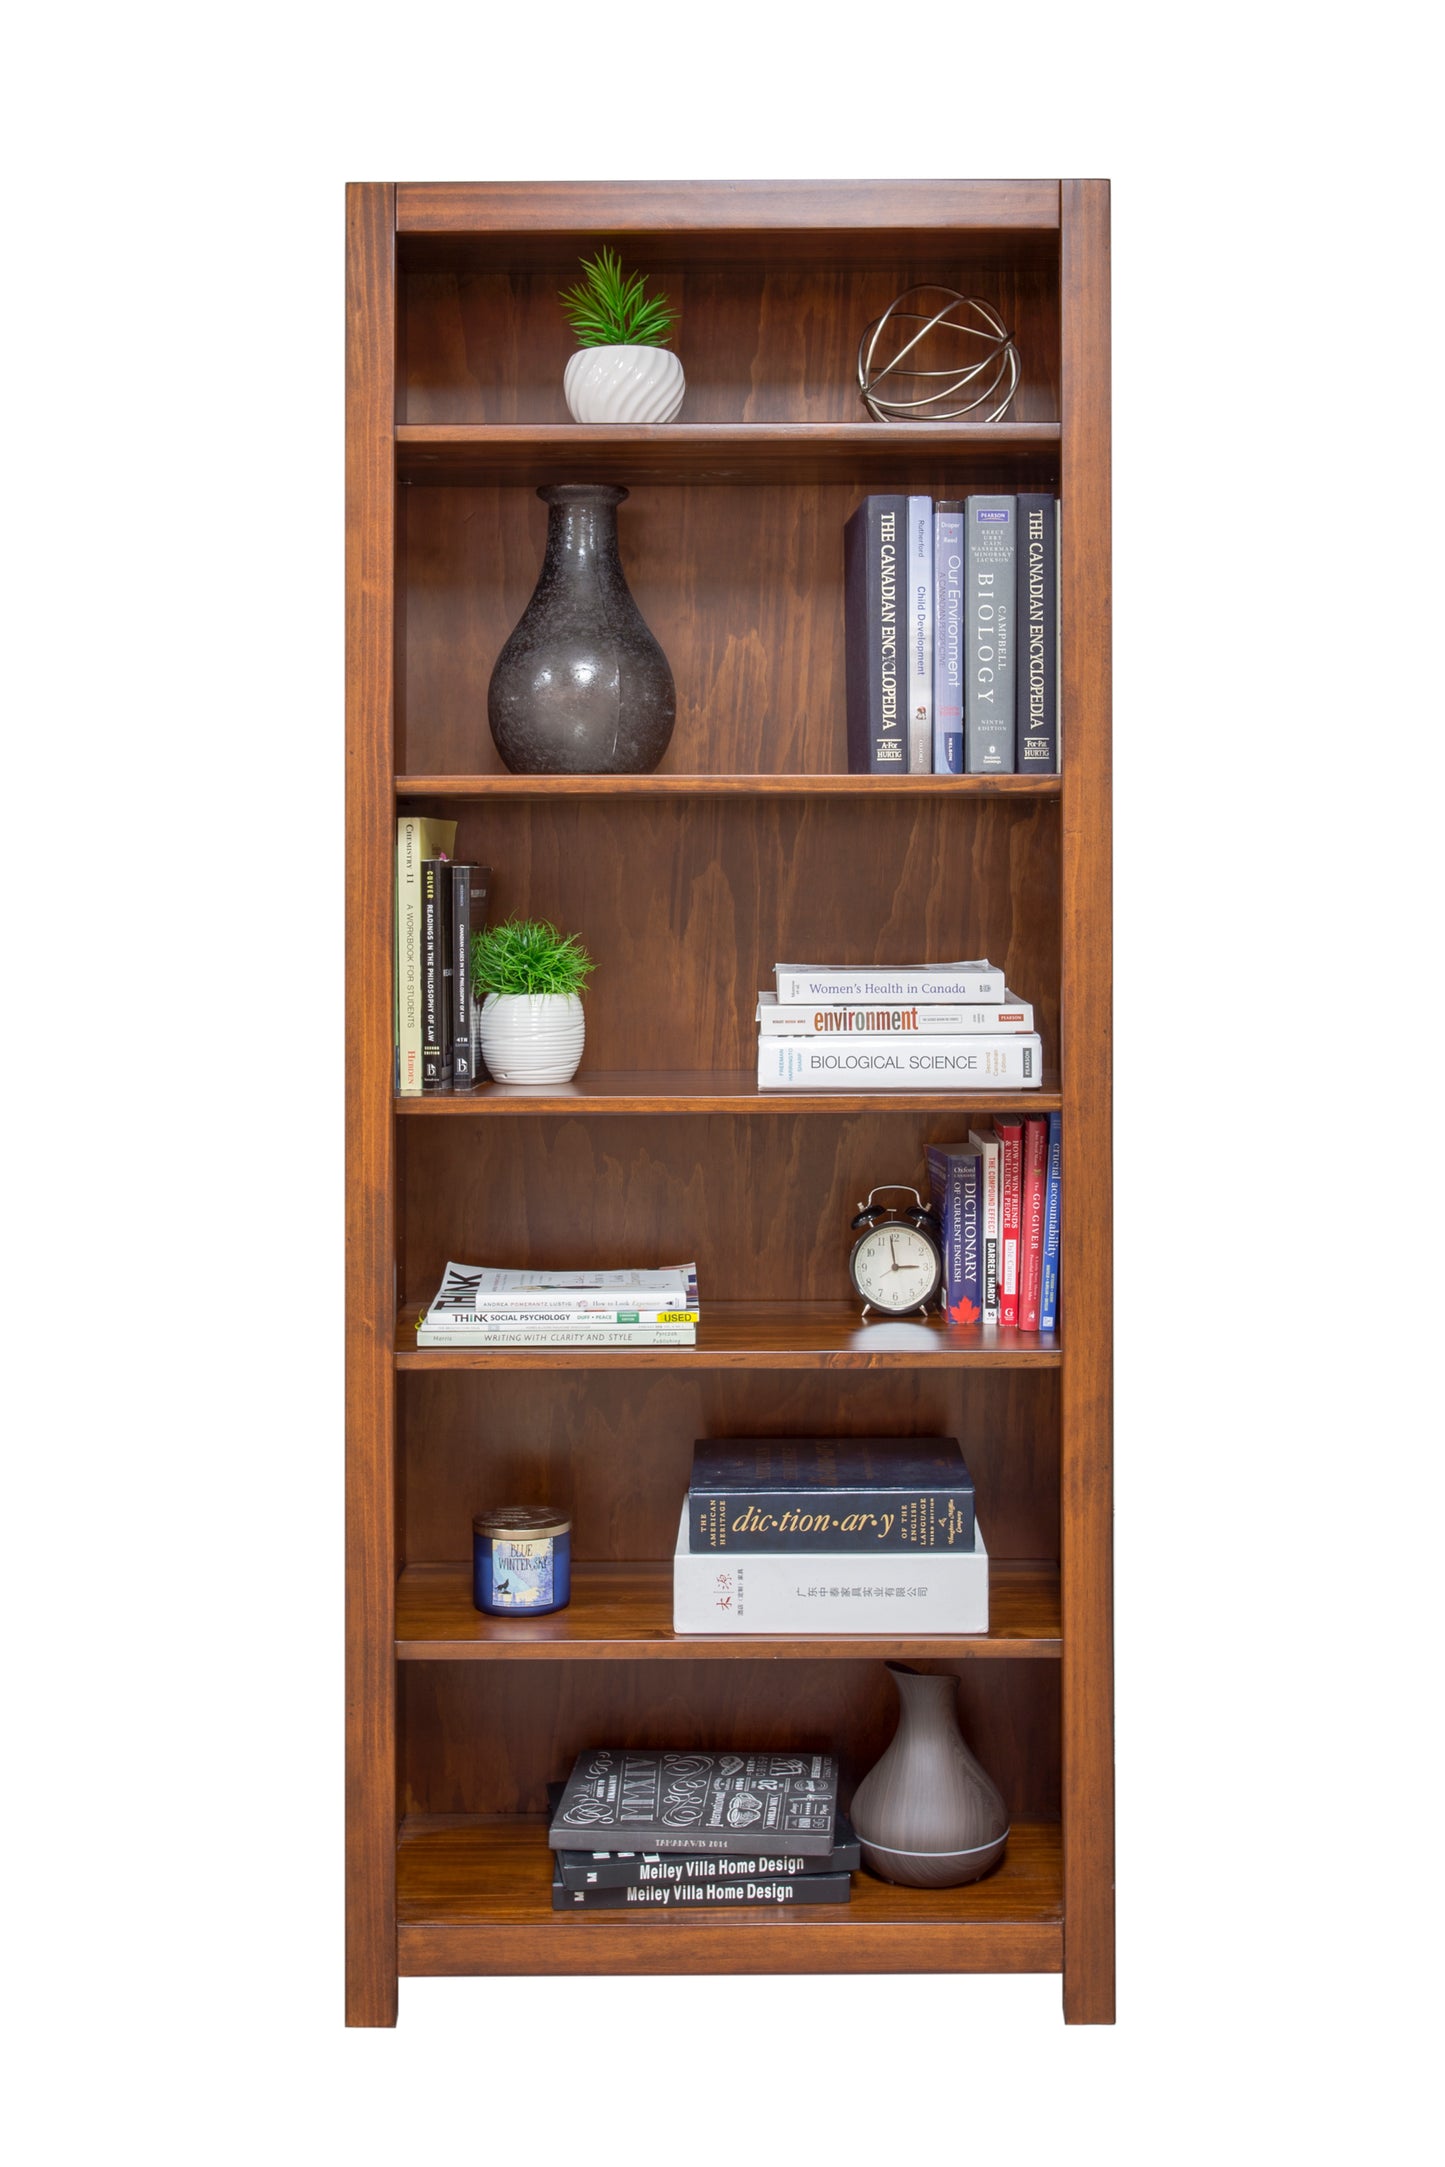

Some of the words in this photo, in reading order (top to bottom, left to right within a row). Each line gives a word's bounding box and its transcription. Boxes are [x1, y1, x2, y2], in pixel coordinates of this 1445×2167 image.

[881, 512, 894, 542] THE
[1029, 510, 1043, 539] THE
[917, 520, 925, 558] Rutherford
[880, 545, 895, 622] CANADIAN
[947, 555, 961, 587] Our
[1029, 543, 1043, 621] CANADIAN
[916, 586, 926, 612] Child
[938, 580, 946, 621] CANADIAN
[916, 614, 926, 676] Development
[938, 621, 946, 667] PERSPECTIVE
[948, 589, 961, 687] Environment
[977, 573, 994, 704] BIOLOGY
[997, 605, 1007, 670] CAMPBELL
[881, 626, 897, 731] ENCYCLOPEDIA
[1030, 625, 1044, 729] ENCYCLOPEDIA
[1024, 749, 1049, 757] HURTIG
[405, 824, 415, 870] CHEMISTRY
[406, 873, 415, 884] 11
[426, 870, 434, 899] CULVER
[426, 904, 435, 940] READINGS
[406, 912, 414, 962] WORKBOOK
[427, 942, 435, 951] IN
[427, 952, 435, 966] THE
[406, 964, 414, 982] FOR
[427, 968, 435, 1013] PHILOSOPHY
[809, 983, 862, 994] Women's
[865, 983, 904, 994] Health
[907, 983, 918, 994] in
[921, 983, 966, 994] Canada
[406, 984, 415, 1029] STUDENTS
[427, 1014, 435, 1024] OF
[814, 1007, 919, 1032] environment
[427, 1025, 435, 1042] LAW
[407, 1050, 416, 1085] HEBDEN
[810, 1055, 904, 1070] BIOLOGICAL
[909, 1055, 977, 1070] SCIENCE
[988, 1157, 996, 1169] THE
[1012, 1162, 1018, 1173] TO
[1051, 1143, 1061, 1179] crucial
[953, 1182, 961, 1195] OF
[988, 1170, 996, 1207] COMPOUND
[953, 1197, 961, 1243] CURRENT
[964, 1182, 976, 1282] DICTIONARY
[987, 1208, 996, 1234] EFFECT
[1031, 1193, 1040, 1250] GO-GIVER
[1045, 1182, 1059, 1258] accountability
[867, 1248, 875, 1256] 10
[878, 1237, 885, 1246] 11
[918, 1248, 924, 1256] 2
[862, 1264, 867, 1273] 9
[923, 1263, 929, 1271] 3
[953, 1245, 962, 1282] ENGLISH
[987, 1242, 996, 1274] DARREN
[866, 1278, 872, 1286] 8
[1006, 1260, 1014, 1293] Carnegie
[434, 1270, 483, 1311] THINK
[878, 1288, 883, 1297] 7
[892, 1292, 898, 1300] 6
[987, 1277, 996, 1305] HARDY
[452, 1314, 489, 1322] THINK
[520, 1314, 571, 1322] PSYCHOLOGY
[664, 1314, 692, 1322] USED
[484, 1334, 522, 1342] WRITING
[550, 1333, 585, 1342] CLARITY
[586, 1333, 606, 1342] AND
[608, 1333, 633, 1342] STYLE
[901, 1527, 908, 1539] OF
[510, 1543, 533, 1557] BLUE
[498, 1557, 532, 1571] WINTER
[533, 1556, 548, 1569] SKY
[796, 1587, 928, 1598] 广东中泰家具实业有限公司
[620, 1756, 656, 1821] MMXIV
[757, 1779, 778, 1790] 20
[706, 1791, 727, 1827] International
[766, 1806, 777, 1825] WORLD
[708, 1840, 729, 1848] 2014
[639, 1863, 683, 1881] Meiley
[686, 1860, 716, 1878] Villa
[719, 1858, 756, 1876] Home
[759, 1855, 805, 1874] Design
[627, 1886, 671, 1904] Meiley
[673, 1884, 704, 1901] Villa
[706, 1884, 744, 1900] Home
[747, 1882, 794, 1902] Design
